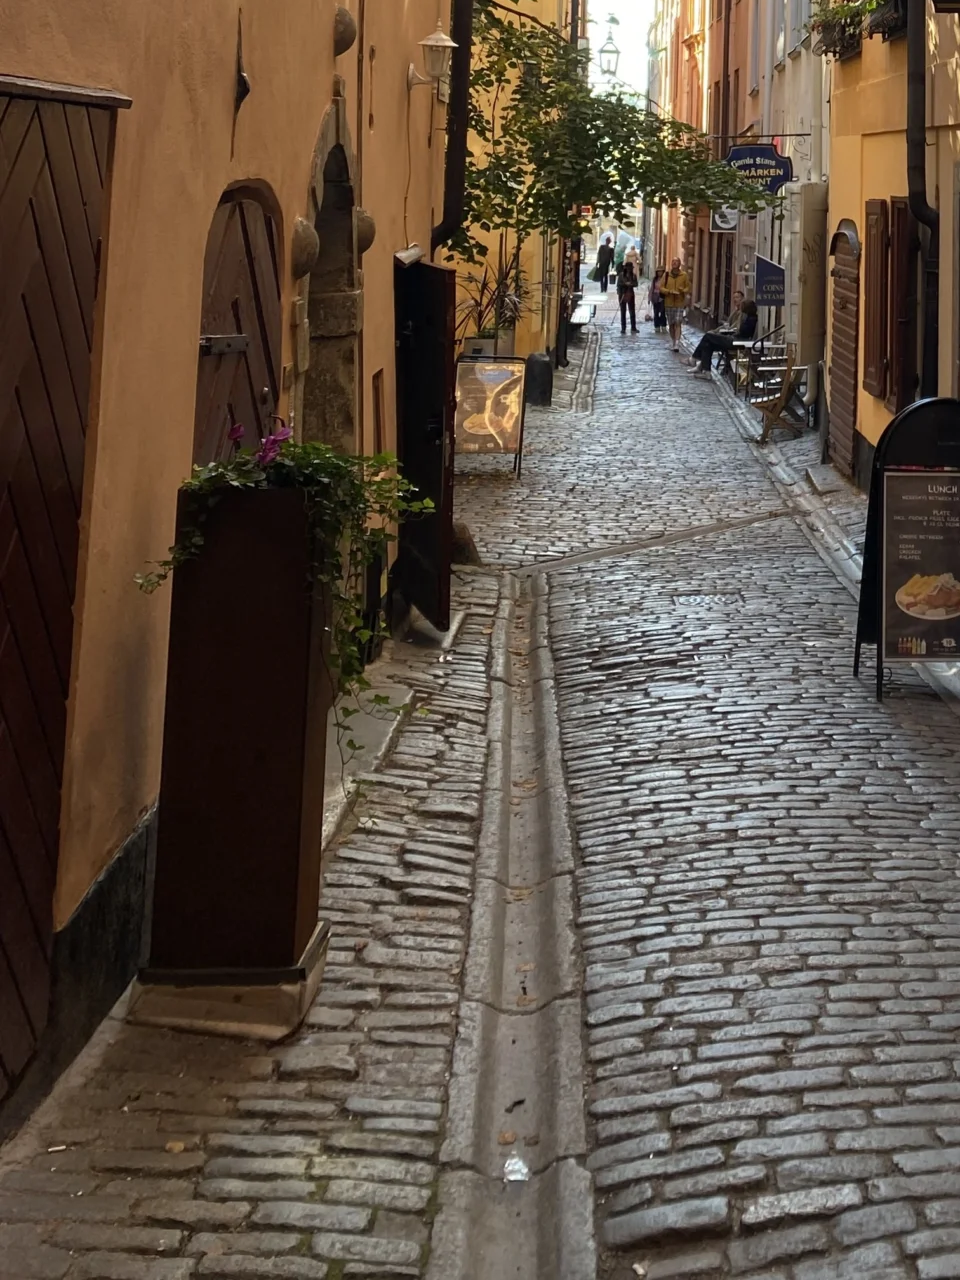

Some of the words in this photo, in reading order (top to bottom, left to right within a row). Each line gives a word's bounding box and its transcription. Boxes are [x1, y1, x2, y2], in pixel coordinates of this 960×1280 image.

[731, 157, 753, 169] Gamla
[756, 157, 776, 166] Stans
[741, 167, 784, 177] MÄRKEN
[928, 484, 958, 494] LUNCH
